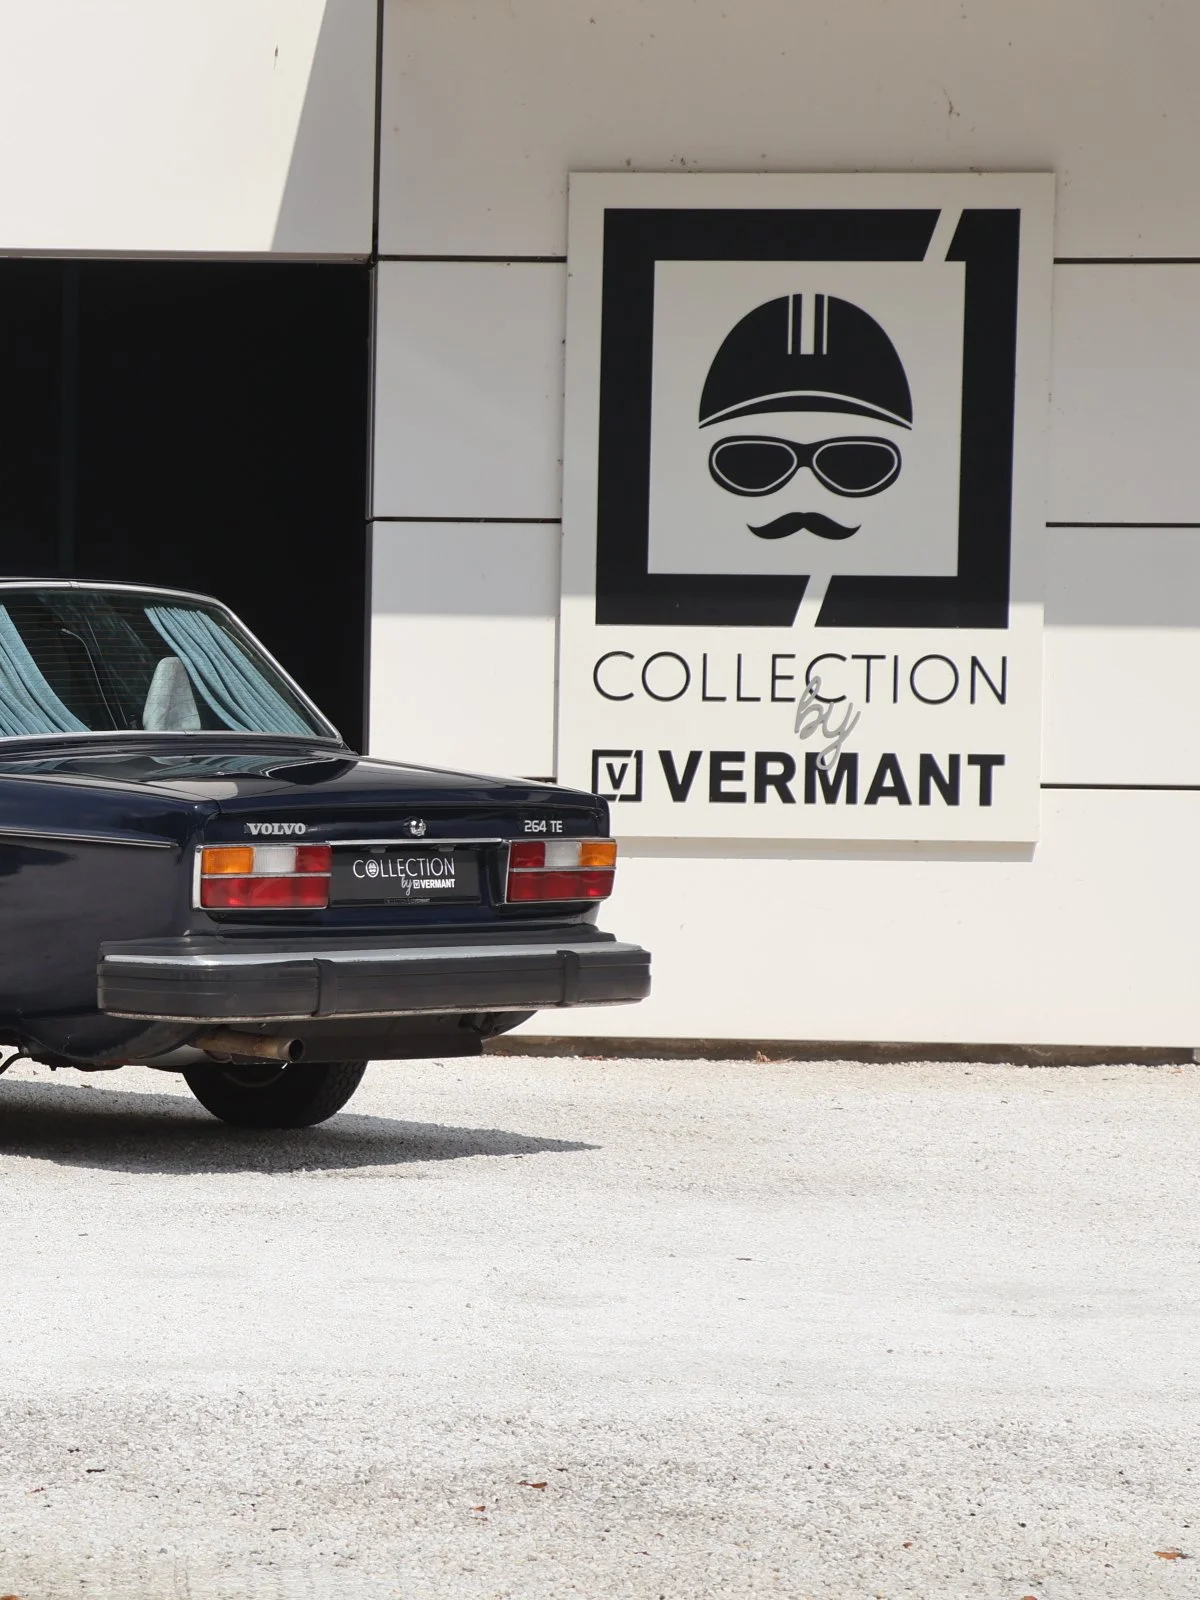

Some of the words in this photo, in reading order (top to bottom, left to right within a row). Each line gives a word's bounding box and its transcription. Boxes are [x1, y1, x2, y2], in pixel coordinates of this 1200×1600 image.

[593, 651, 1007, 705] COLLECTION
[794, 675, 861, 771] by
[658, 750, 1006, 806] VERMANT
[246, 822, 306, 835] VOLVO
[524, 820, 547, 832] 264
[550, 820, 563, 832] TE
[352, 858, 455, 878] COLLECTION
[401, 876, 413, 896] by
[420, 879, 456, 889] VERMANT
